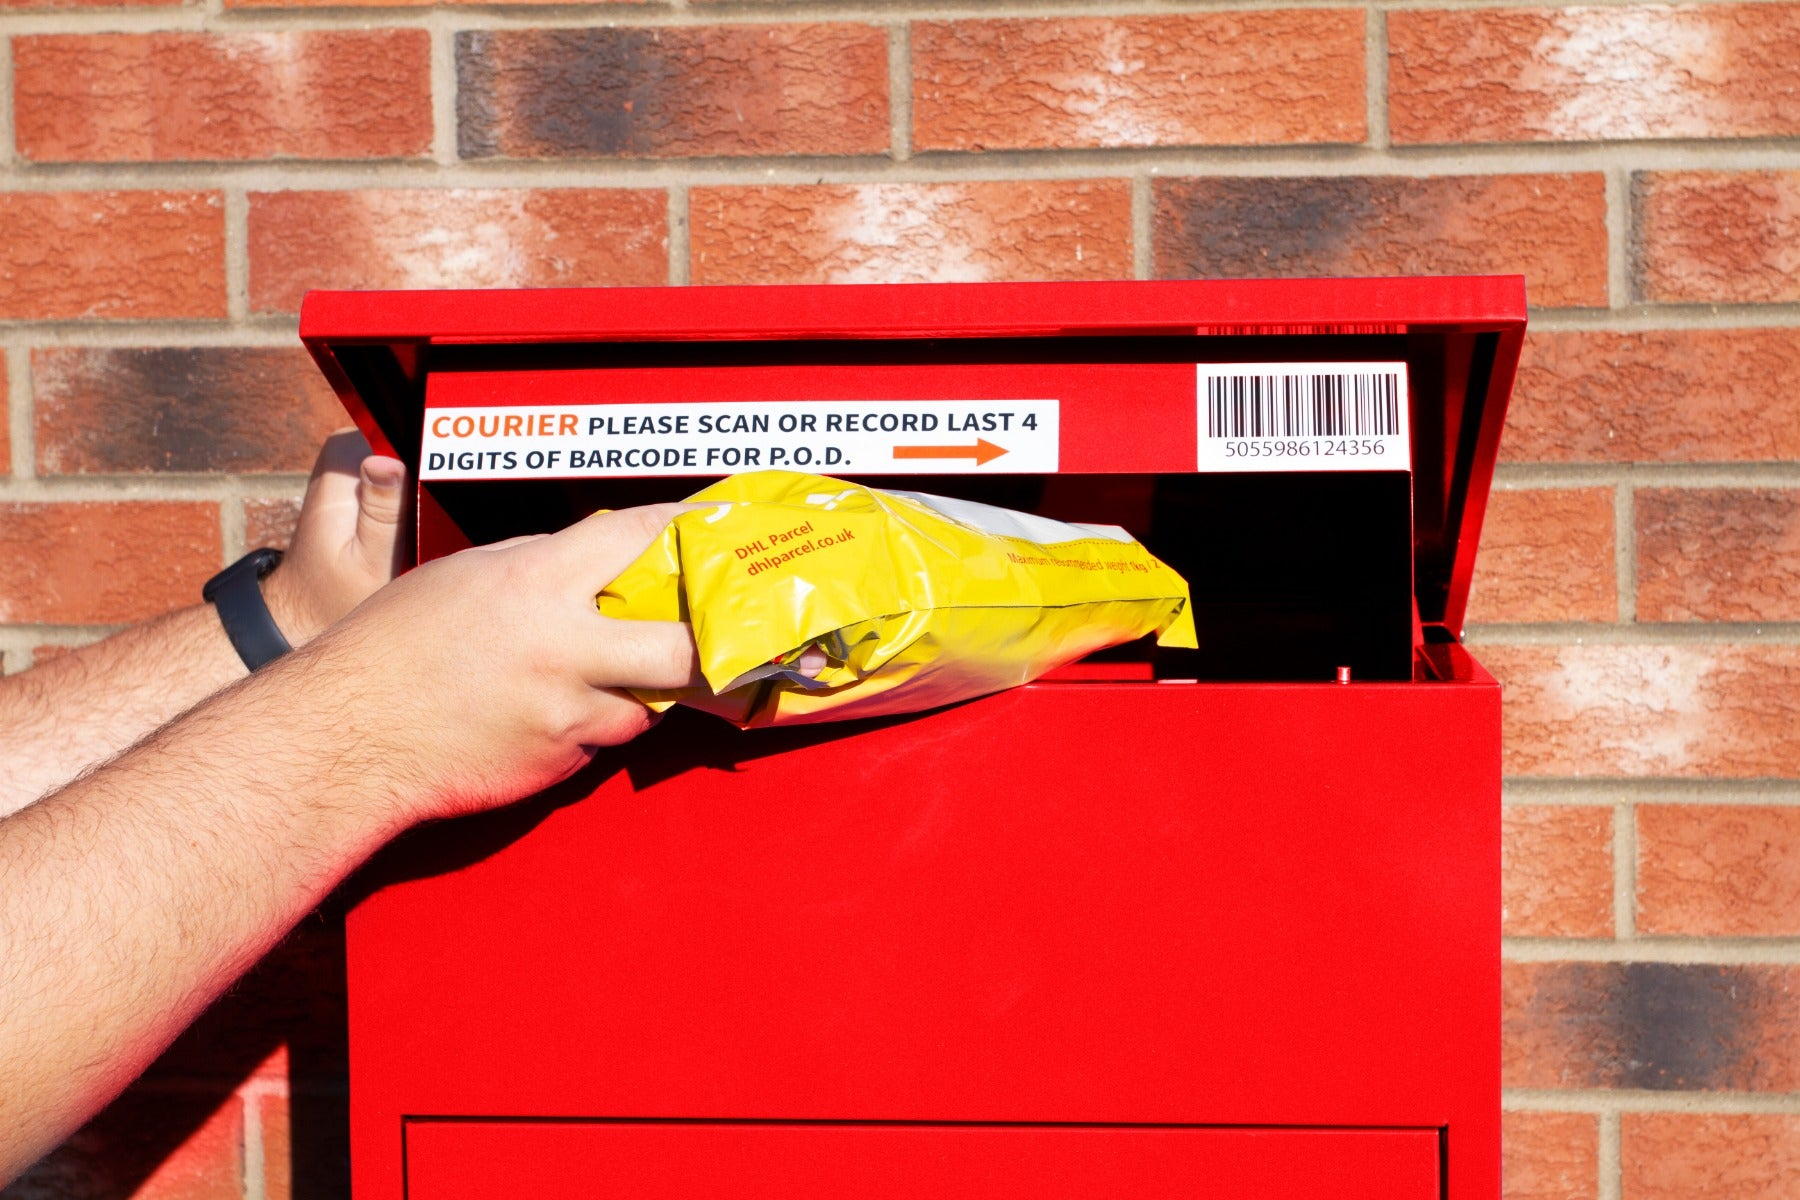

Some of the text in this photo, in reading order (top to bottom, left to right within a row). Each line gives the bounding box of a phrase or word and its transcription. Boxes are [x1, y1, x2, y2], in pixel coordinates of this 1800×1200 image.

[432, 412, 1038, 439] COURIER PLEASE SCAN OR RECORD LAST 4
[428, 446, 851, 471] DIGITS OF BARCODE FOR P.O.D.
[1225, 440, 1385, 457] 5055986124356
[734, 520, 814, 560] DHL Parcel
[747, 528, 855, 576] dhlparcel.co.uk
[1007, 552, 1050, 566] Maximum
[1106, 558, 1130, 574] weight
[1151, 559, 1161, 569] 2
